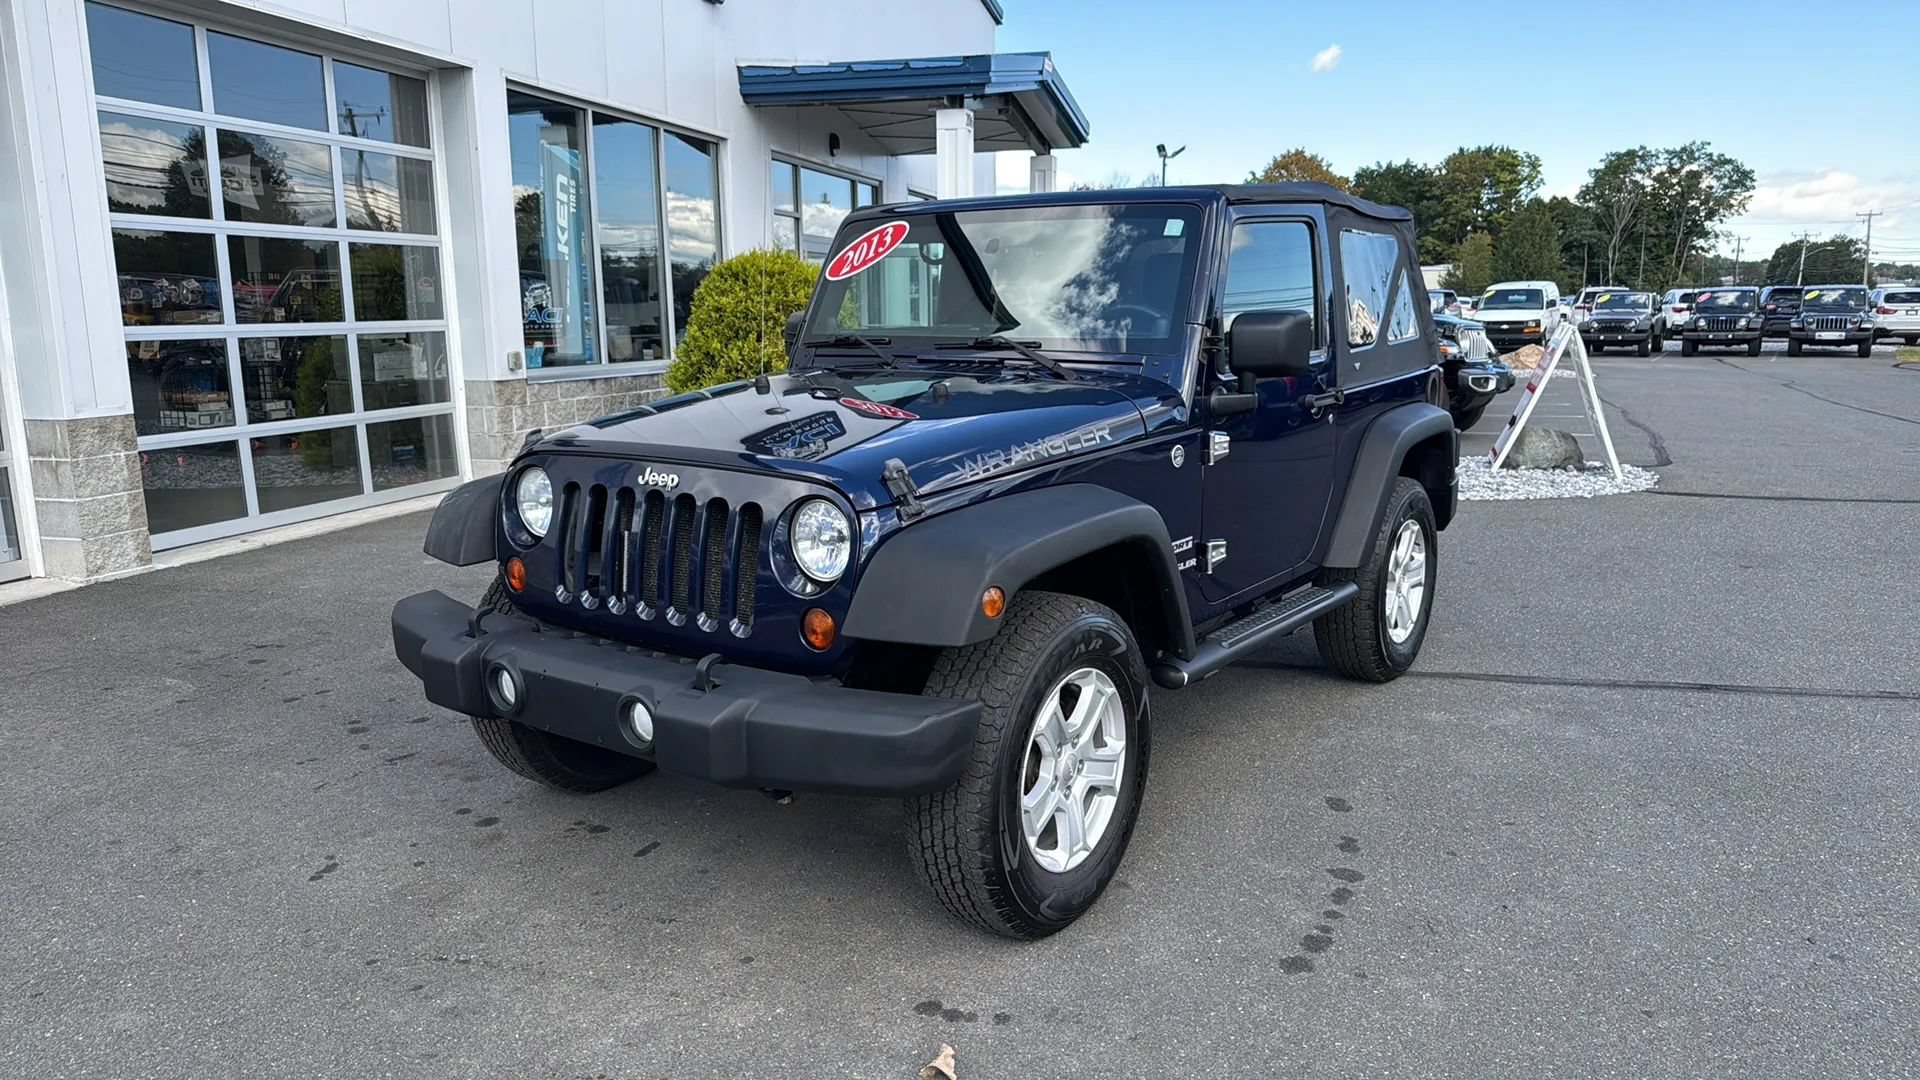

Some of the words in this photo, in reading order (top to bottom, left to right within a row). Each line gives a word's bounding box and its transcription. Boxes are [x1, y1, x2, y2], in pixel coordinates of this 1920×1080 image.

[569, 179, 577, 214] TIRES
[556, 173, 569, 261] KEN
[839, 226, 894, 276] 2013
[523, 307, 564, 324] ACI
[952, 425, 1113, 479] WRANGLER
[637, 466, 679, 491] Jeep
[1171, 536, 1194, 554] ORT
